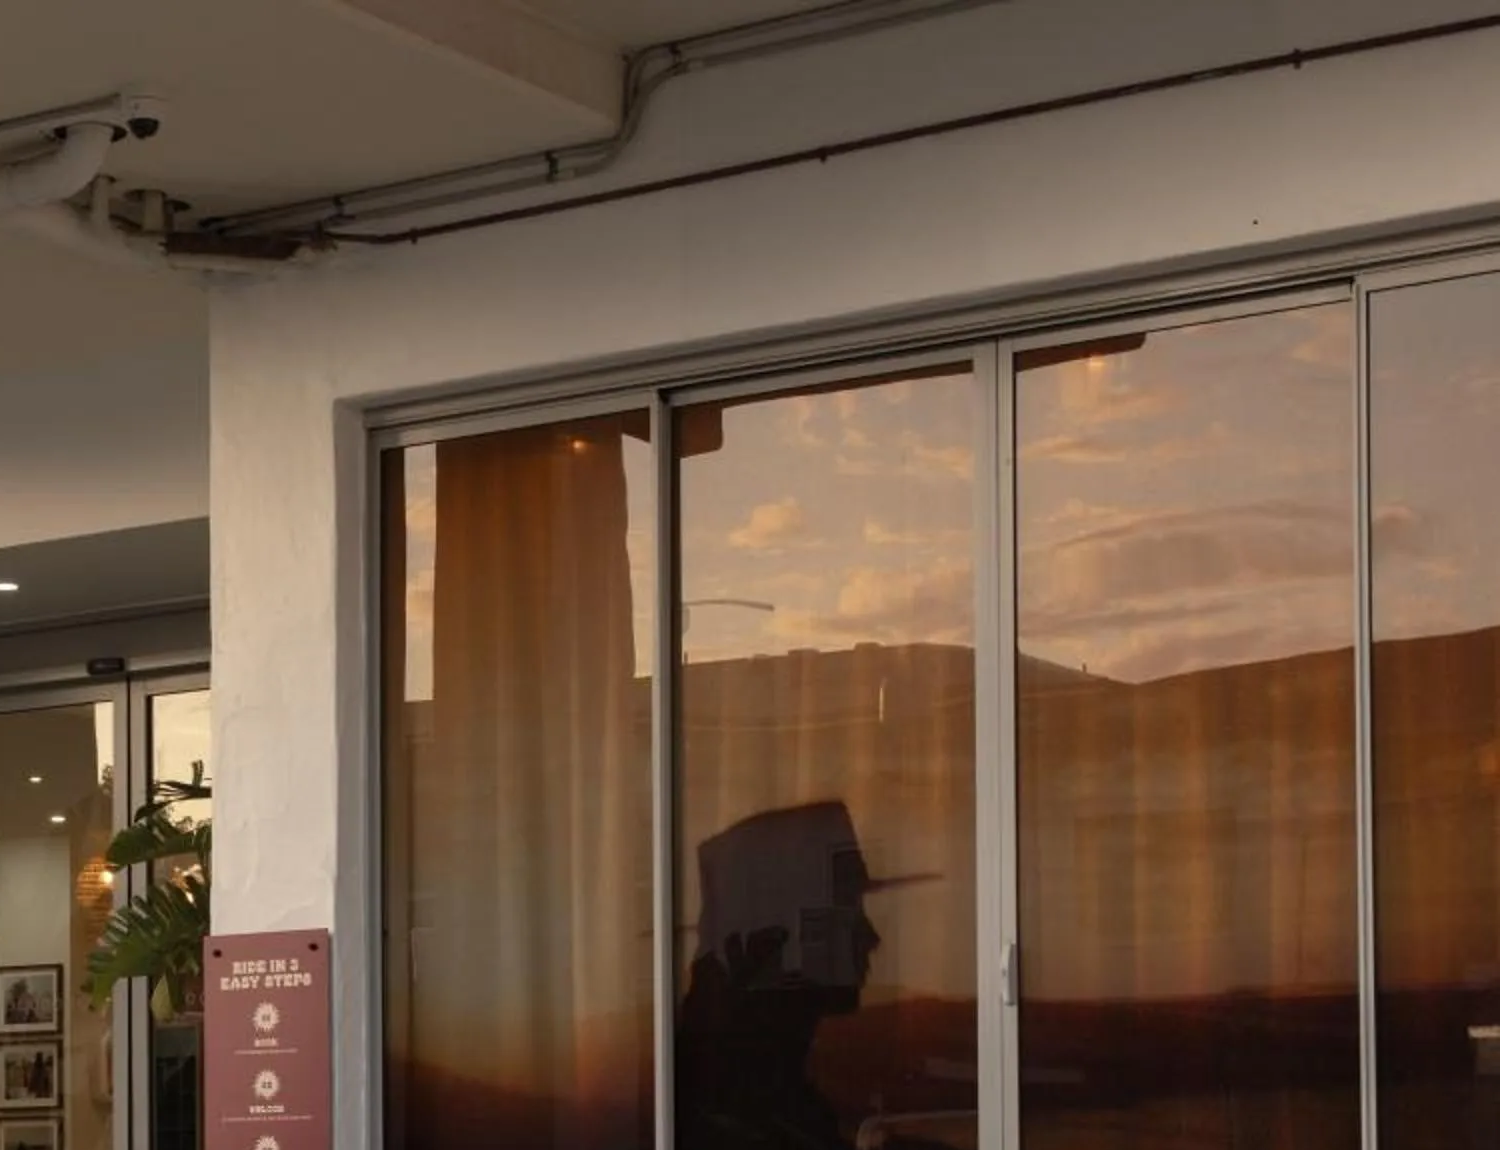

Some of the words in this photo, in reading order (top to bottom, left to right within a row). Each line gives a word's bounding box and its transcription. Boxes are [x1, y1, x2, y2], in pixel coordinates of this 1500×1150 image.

[232, 961, 266, 974] RIDE
[269, 959, 286, 972] IN
[290, 958, 299, 971] 3
[220, 976, 260, 990] EASY
[264, 972, 312, 987] STEPS
